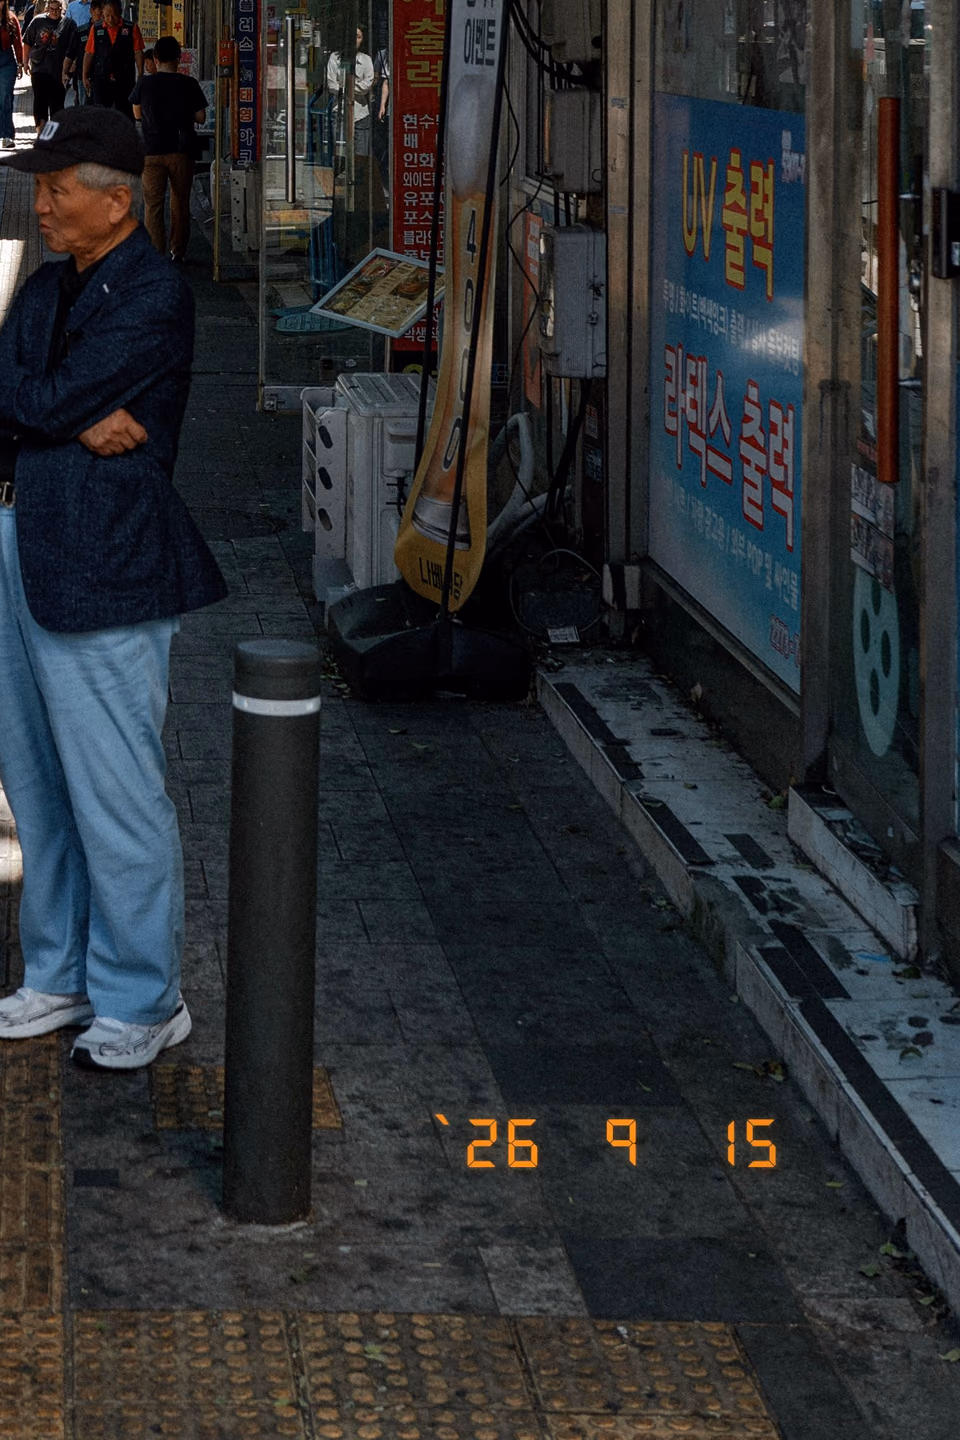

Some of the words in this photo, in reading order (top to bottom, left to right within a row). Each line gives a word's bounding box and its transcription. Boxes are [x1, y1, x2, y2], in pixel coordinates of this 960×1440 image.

[463, 18, 496, 67] 이벤트
[402, 113, 440, 130] 현수
[403, 151, 444, 169] 인화
[402, 172, 444, 188] 와이드
[681, 149, 718, 263] UV
[722, 146, 776, 303] 출력
[664, 341, 733, 488] 라텍스
[739, 377, 795, 553] 출력
